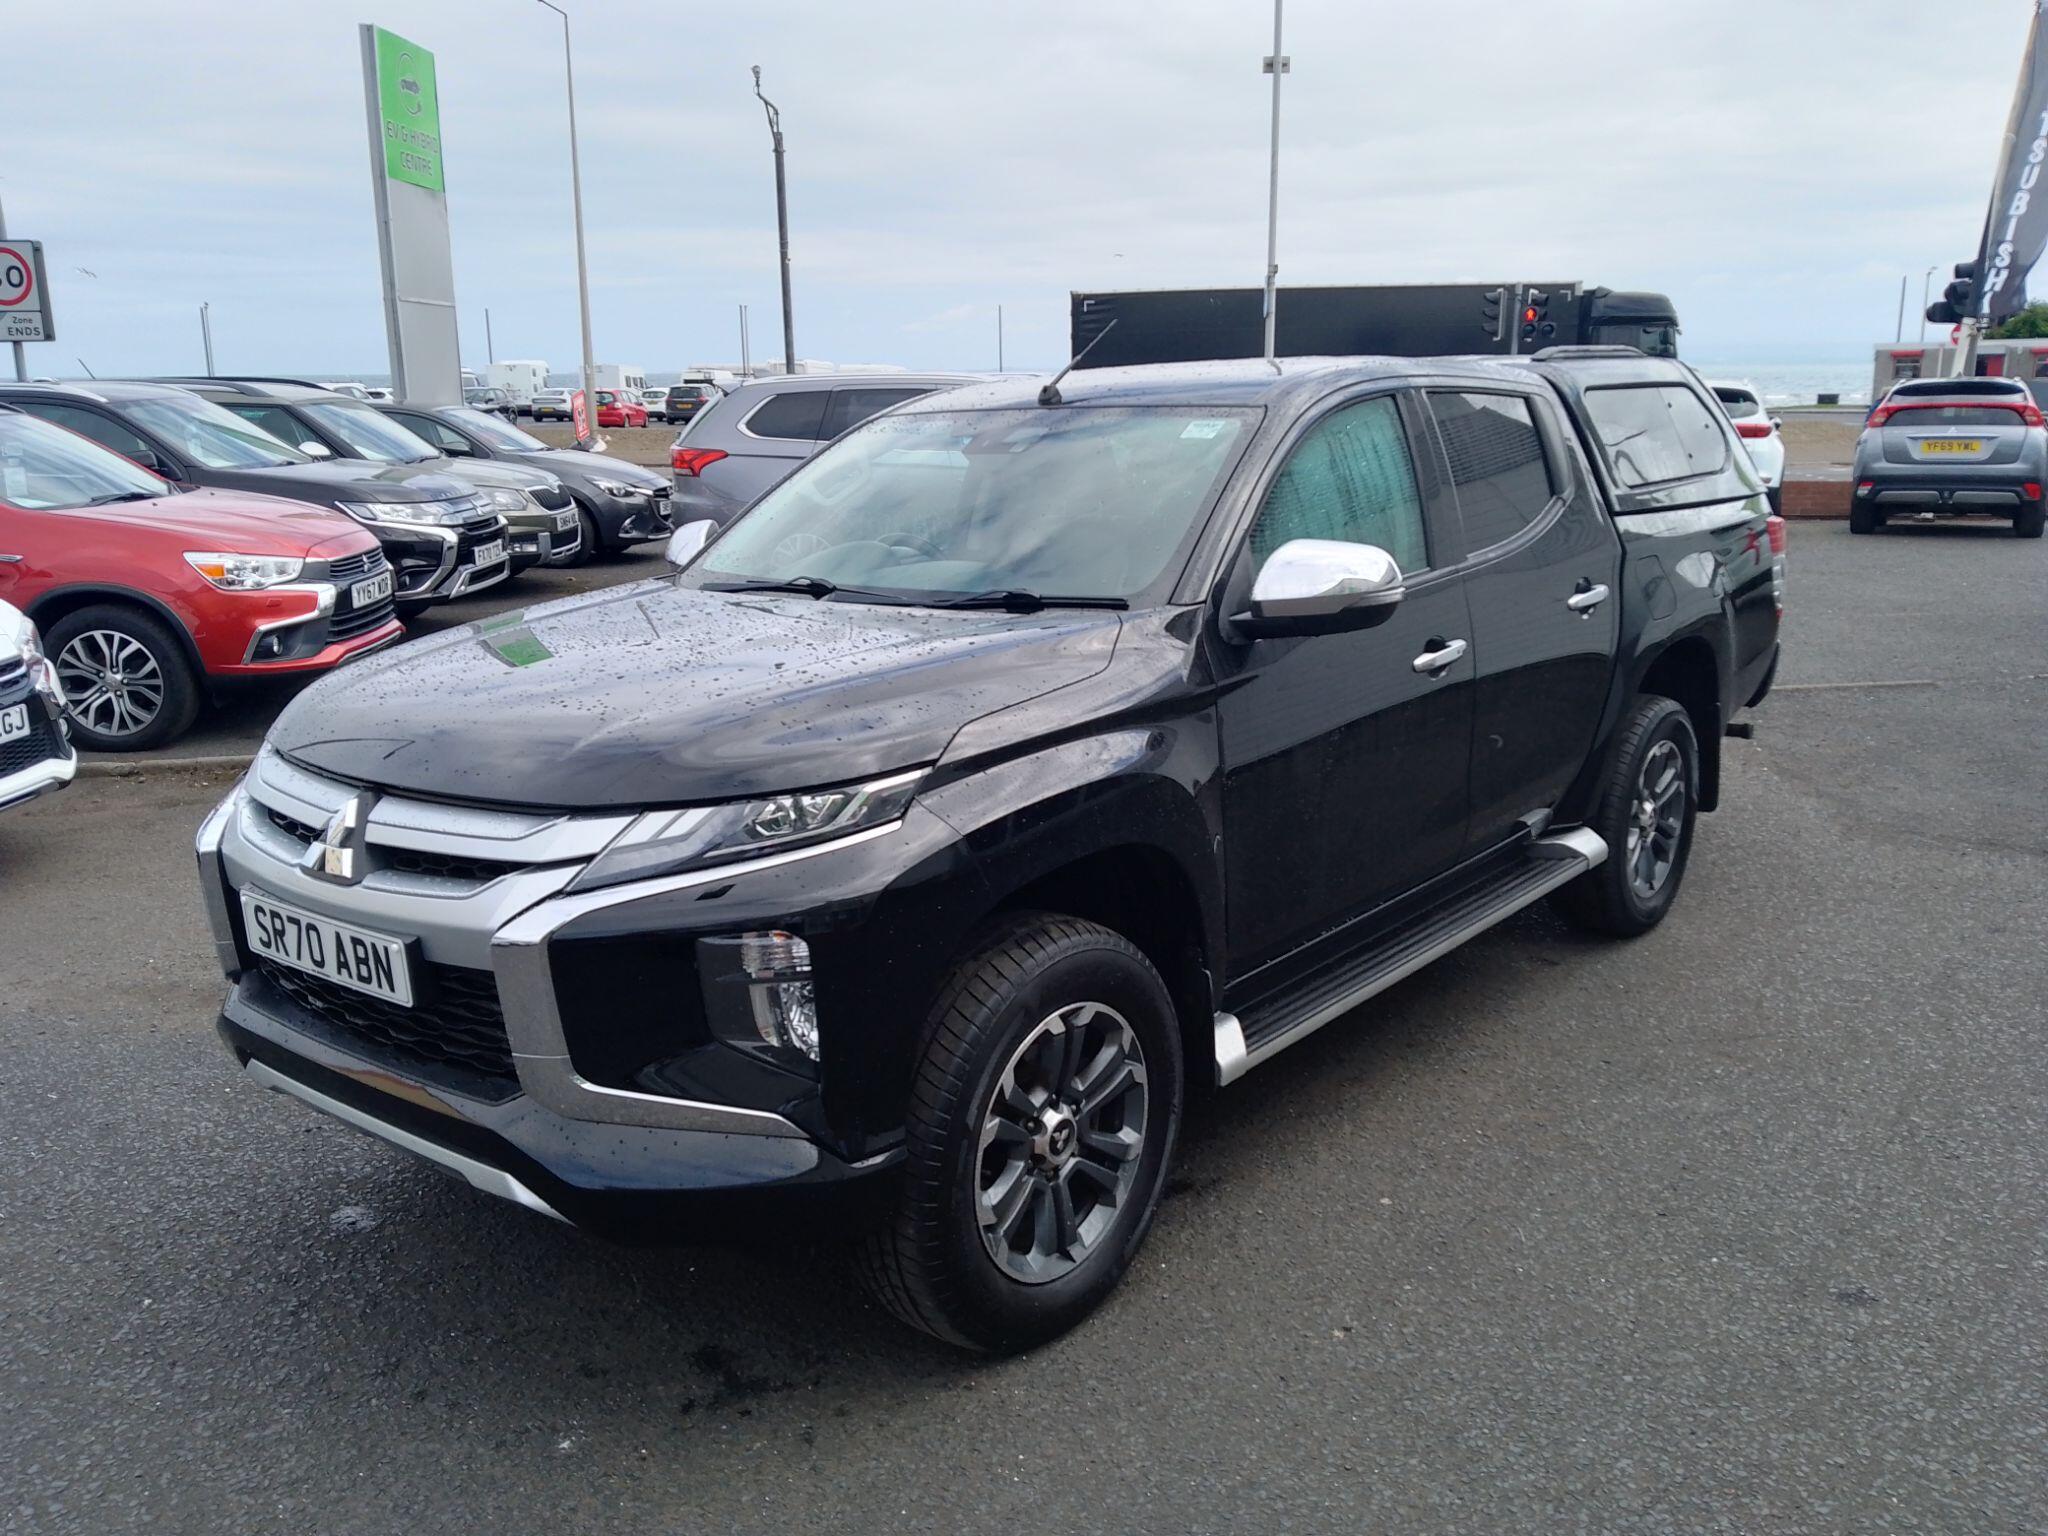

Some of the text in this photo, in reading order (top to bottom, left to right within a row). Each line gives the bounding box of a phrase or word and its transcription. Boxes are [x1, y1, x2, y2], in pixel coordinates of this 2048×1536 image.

[386, 120, 439, 154] EV & HYBRID
[400, 151, 433, 176] CENTRE
[0, 265, 24, 288] 0
[8, 327, 41, 336] ENDS
[12, 316, 33, 324] Zone
[355, 581, 375, 603] YY67
[0, 708, 25, 737] GJ
[253, 904, 396, 993] SR70 ABN
